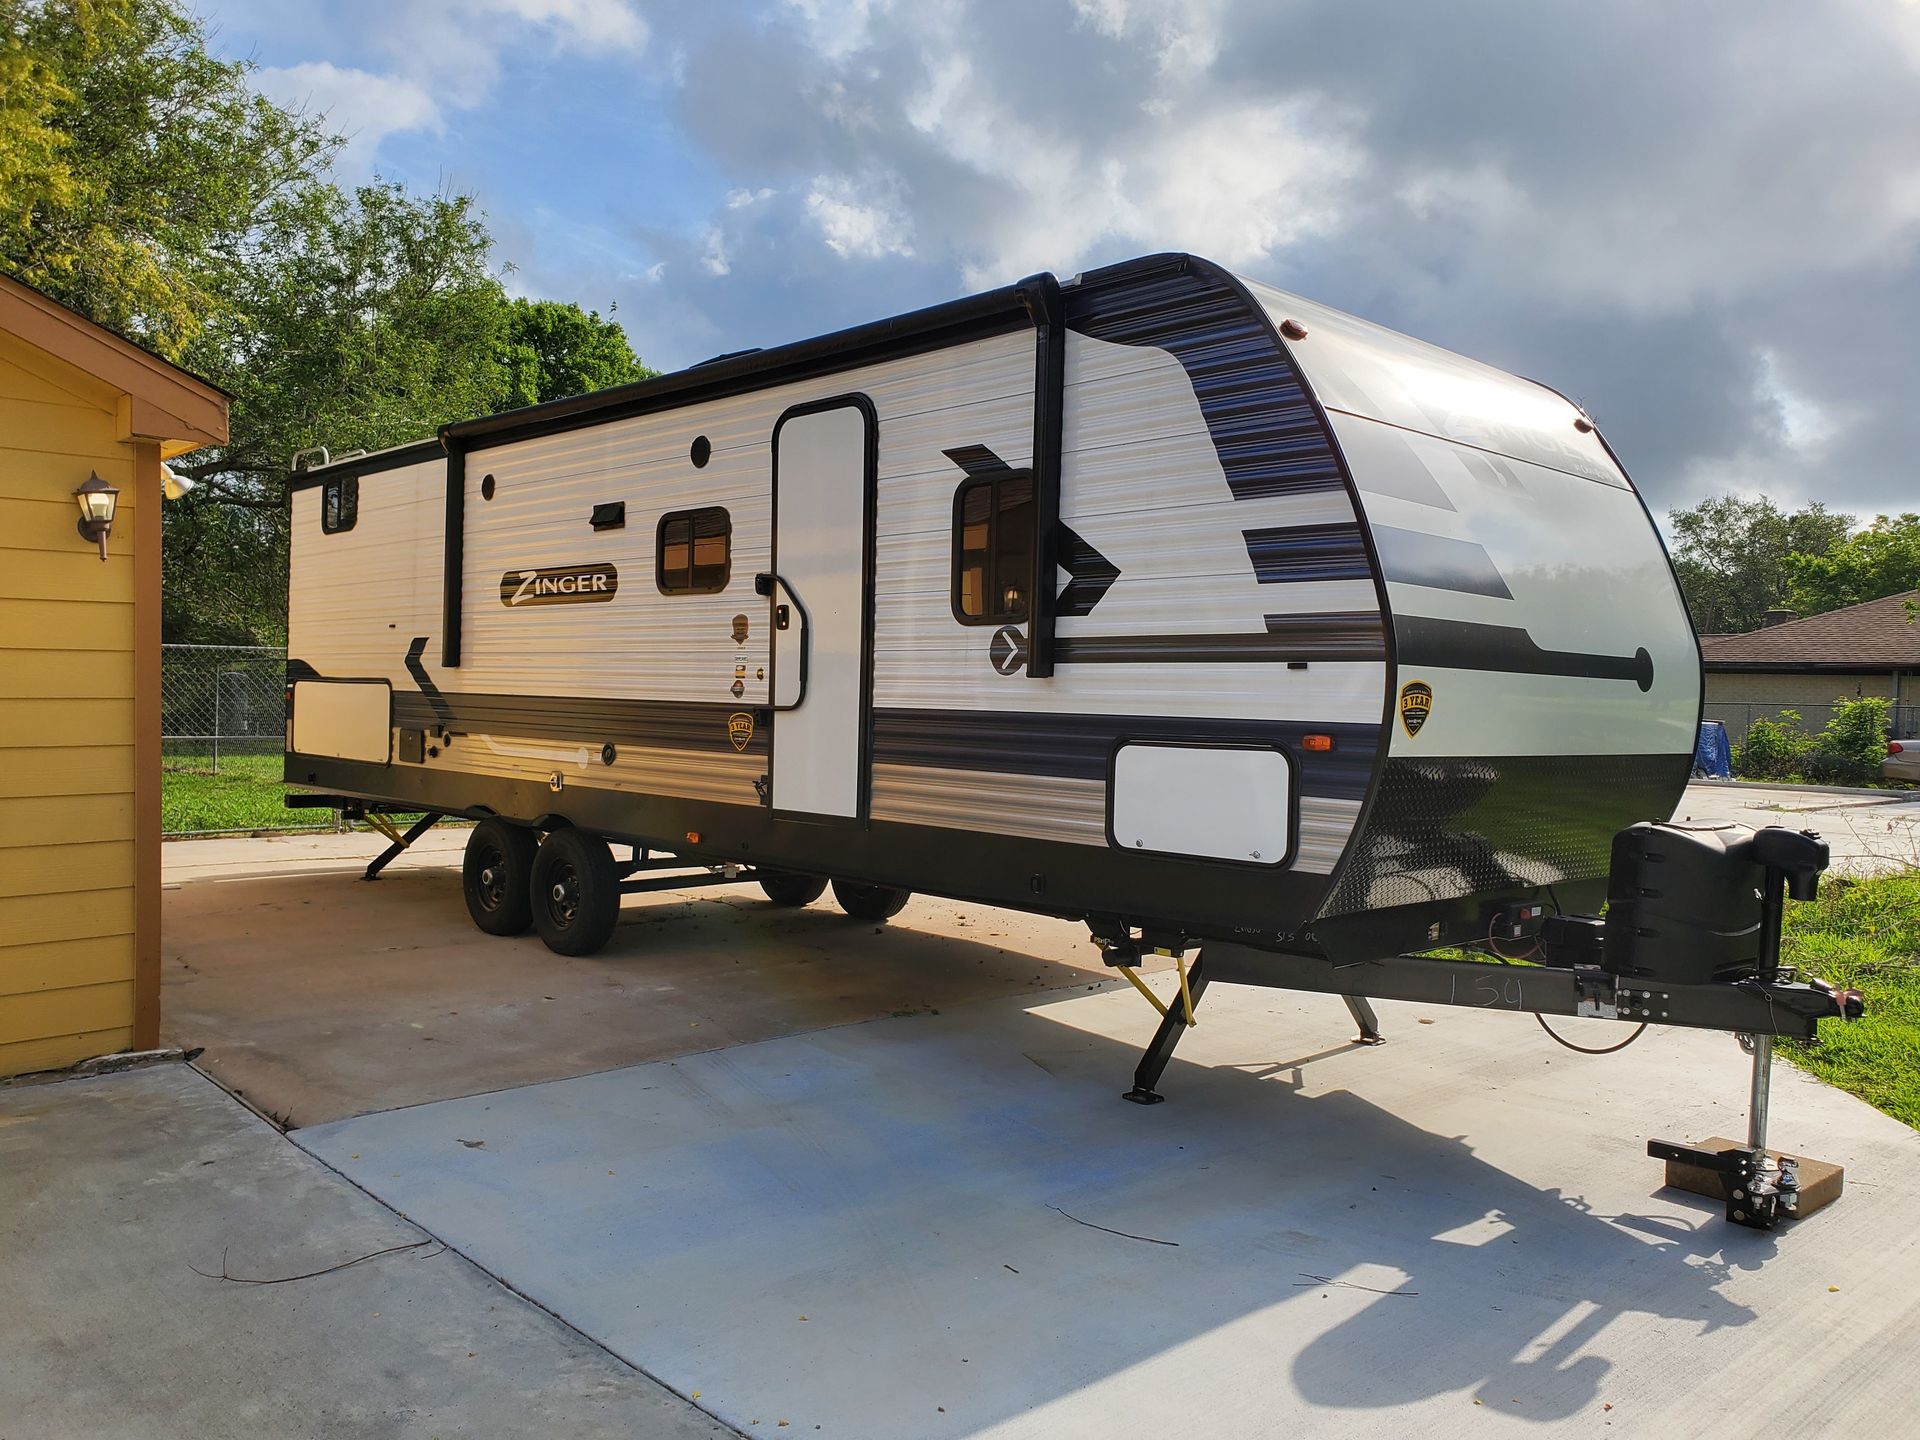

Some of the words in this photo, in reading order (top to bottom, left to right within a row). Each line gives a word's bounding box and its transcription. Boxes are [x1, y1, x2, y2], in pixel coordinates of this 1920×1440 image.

[510, 570, 607, 605] ZINGER
[1403, 698, 1408, 708] 3
[1410, 696, 1430, 709] YEAR
[736, 722, 751, 730] YEAR
